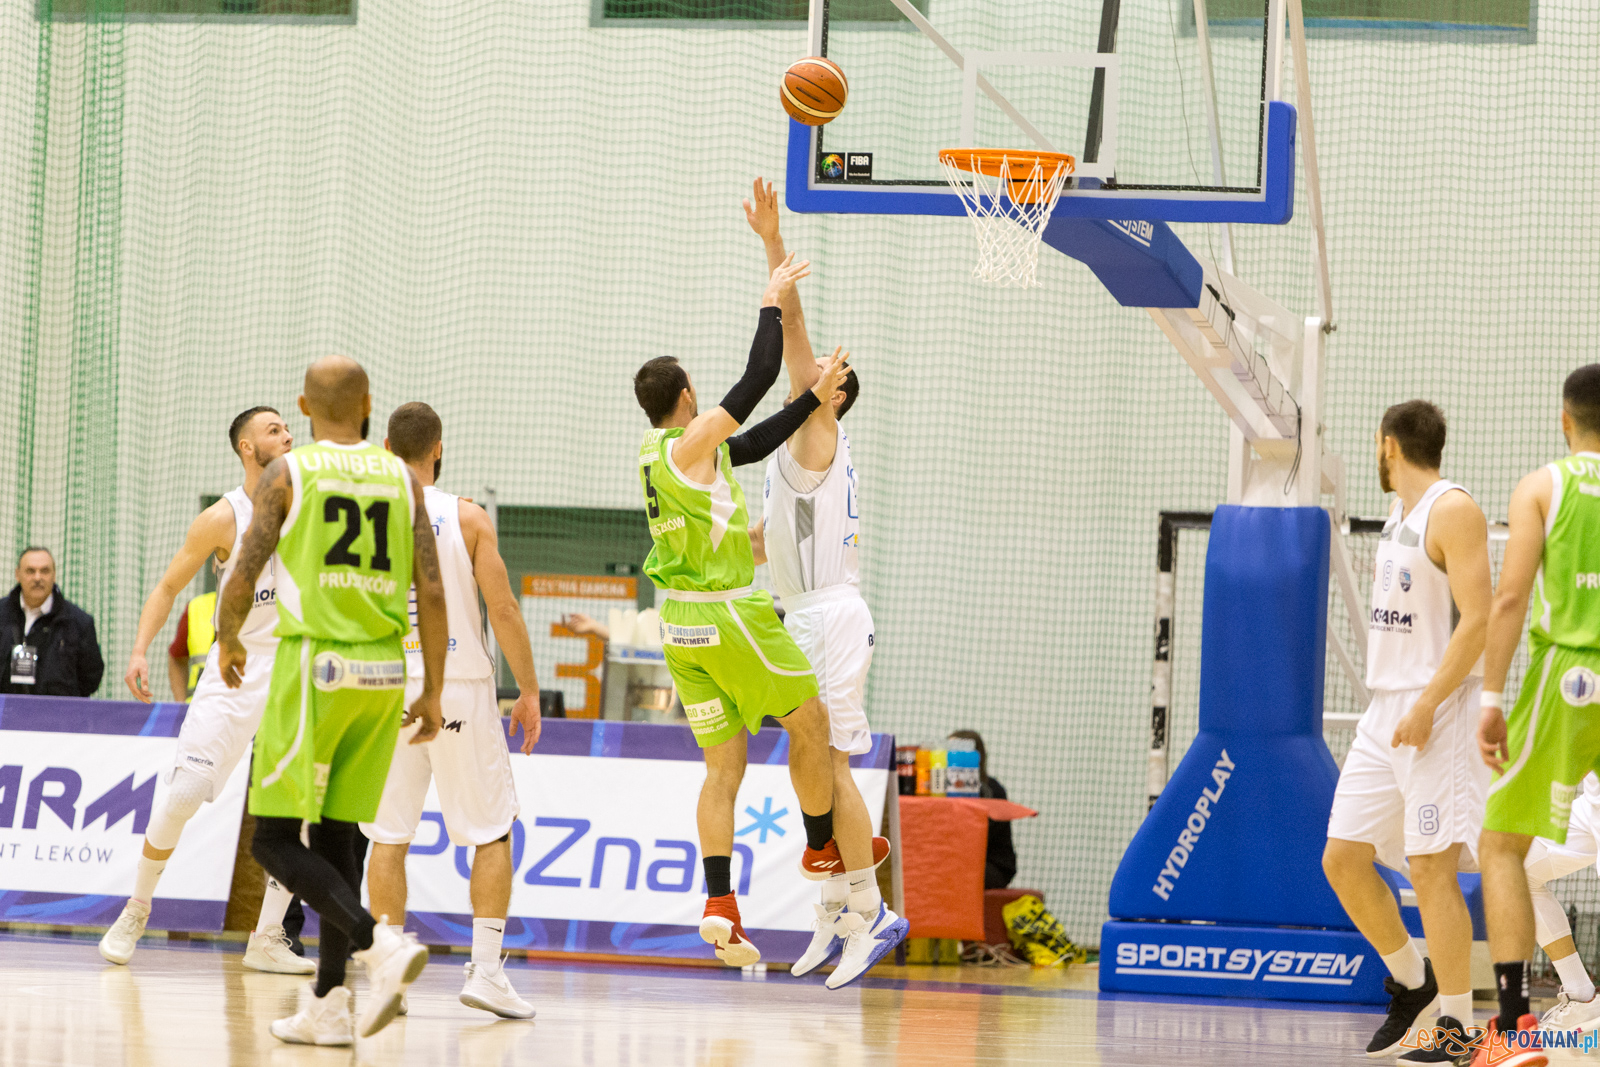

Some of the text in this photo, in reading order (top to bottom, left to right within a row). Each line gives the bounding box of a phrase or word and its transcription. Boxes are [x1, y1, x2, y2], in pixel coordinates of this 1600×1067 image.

[850, 155, 870, 166] FIBA
[644, 465, 660, 519] 5
[324, 495, 391, 572] 21
[1575, 572, 1600, 590] PR
[550, 622, 605, 719] 3
[187, 755, 214, 767] macron
[1152, 748, 1236, 902] HYDROPLAY
[1418, 803, 1440, 836] 8
[34, 842, 114, 864] LEKÓW
[1115, 942, 1365, 981] SPORTSYSTEM
